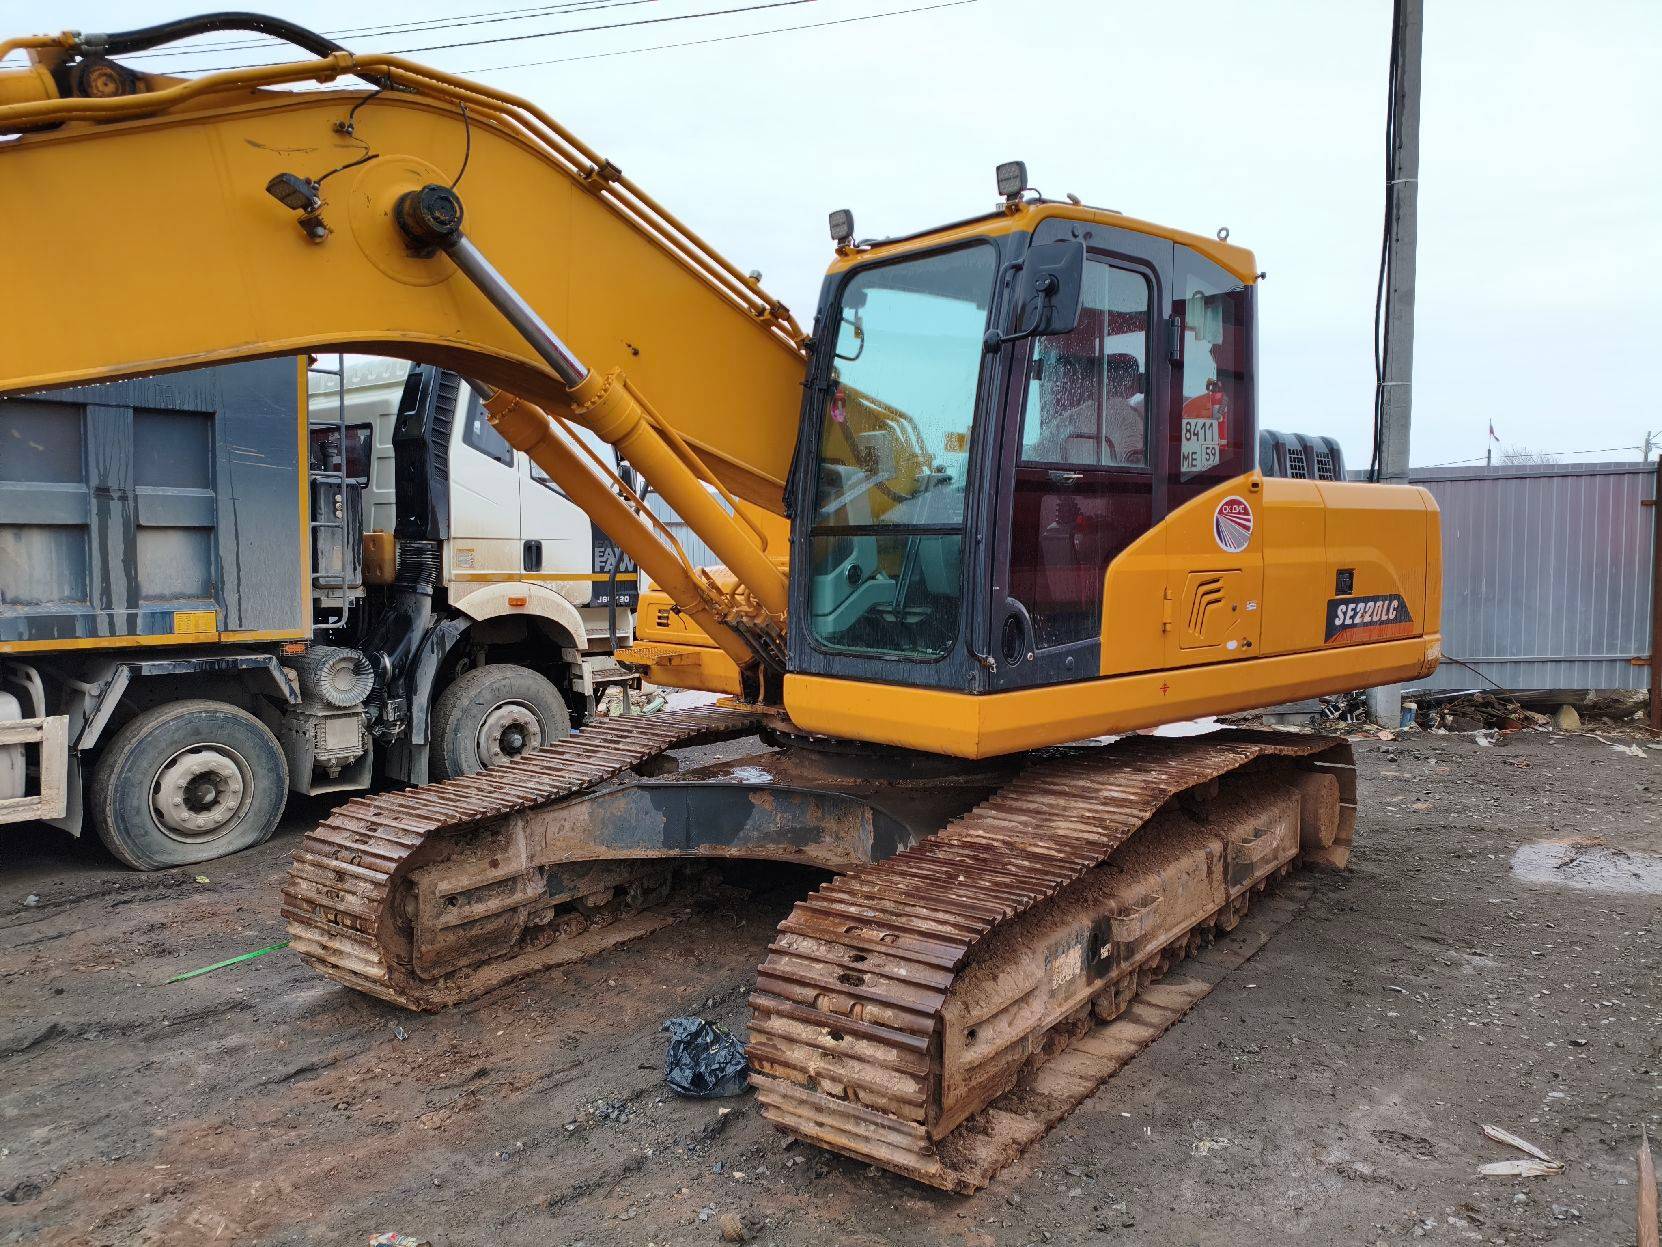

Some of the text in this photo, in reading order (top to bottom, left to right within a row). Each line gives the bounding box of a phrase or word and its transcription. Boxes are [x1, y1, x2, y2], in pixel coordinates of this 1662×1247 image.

[1184, 421, 1214, 442] 8411
[1205, 446, 1217, 462] 59
[1334, 599, 1399, 626] SE220LC
